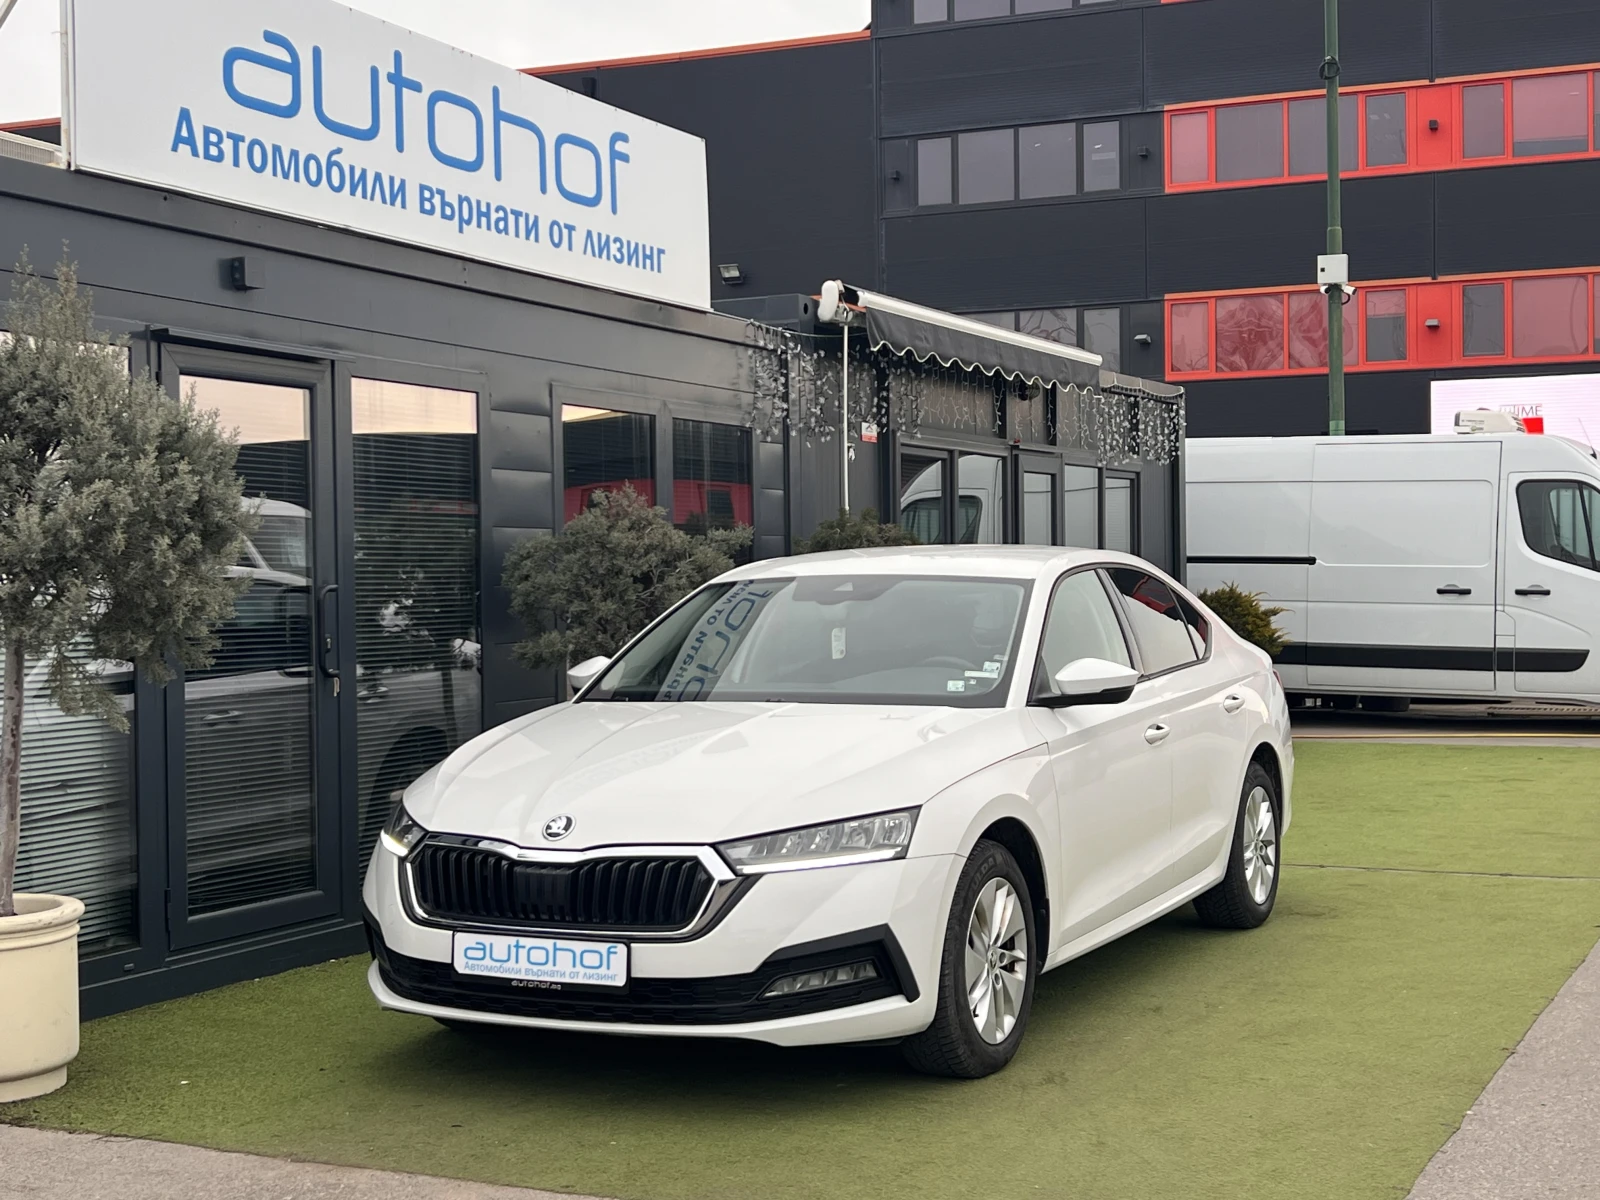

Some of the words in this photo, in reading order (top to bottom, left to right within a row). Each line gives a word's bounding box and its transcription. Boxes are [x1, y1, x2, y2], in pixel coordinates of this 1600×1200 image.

[222, 29, 630, 214] autohof
[171, 107, 408, 210] Автомобили
[418, 183, 540, 242] върнати
[548, 219, 577, 250] от
[583, 230, 666, 274] лизинг
[463, 939, 618, 971] autohof
[464, 961, 522, 976] Автомобили
[524, 967, 566, 980] върнати
[568, 971, 580, 980] от
[582, 971, 619, 982] лизинг
